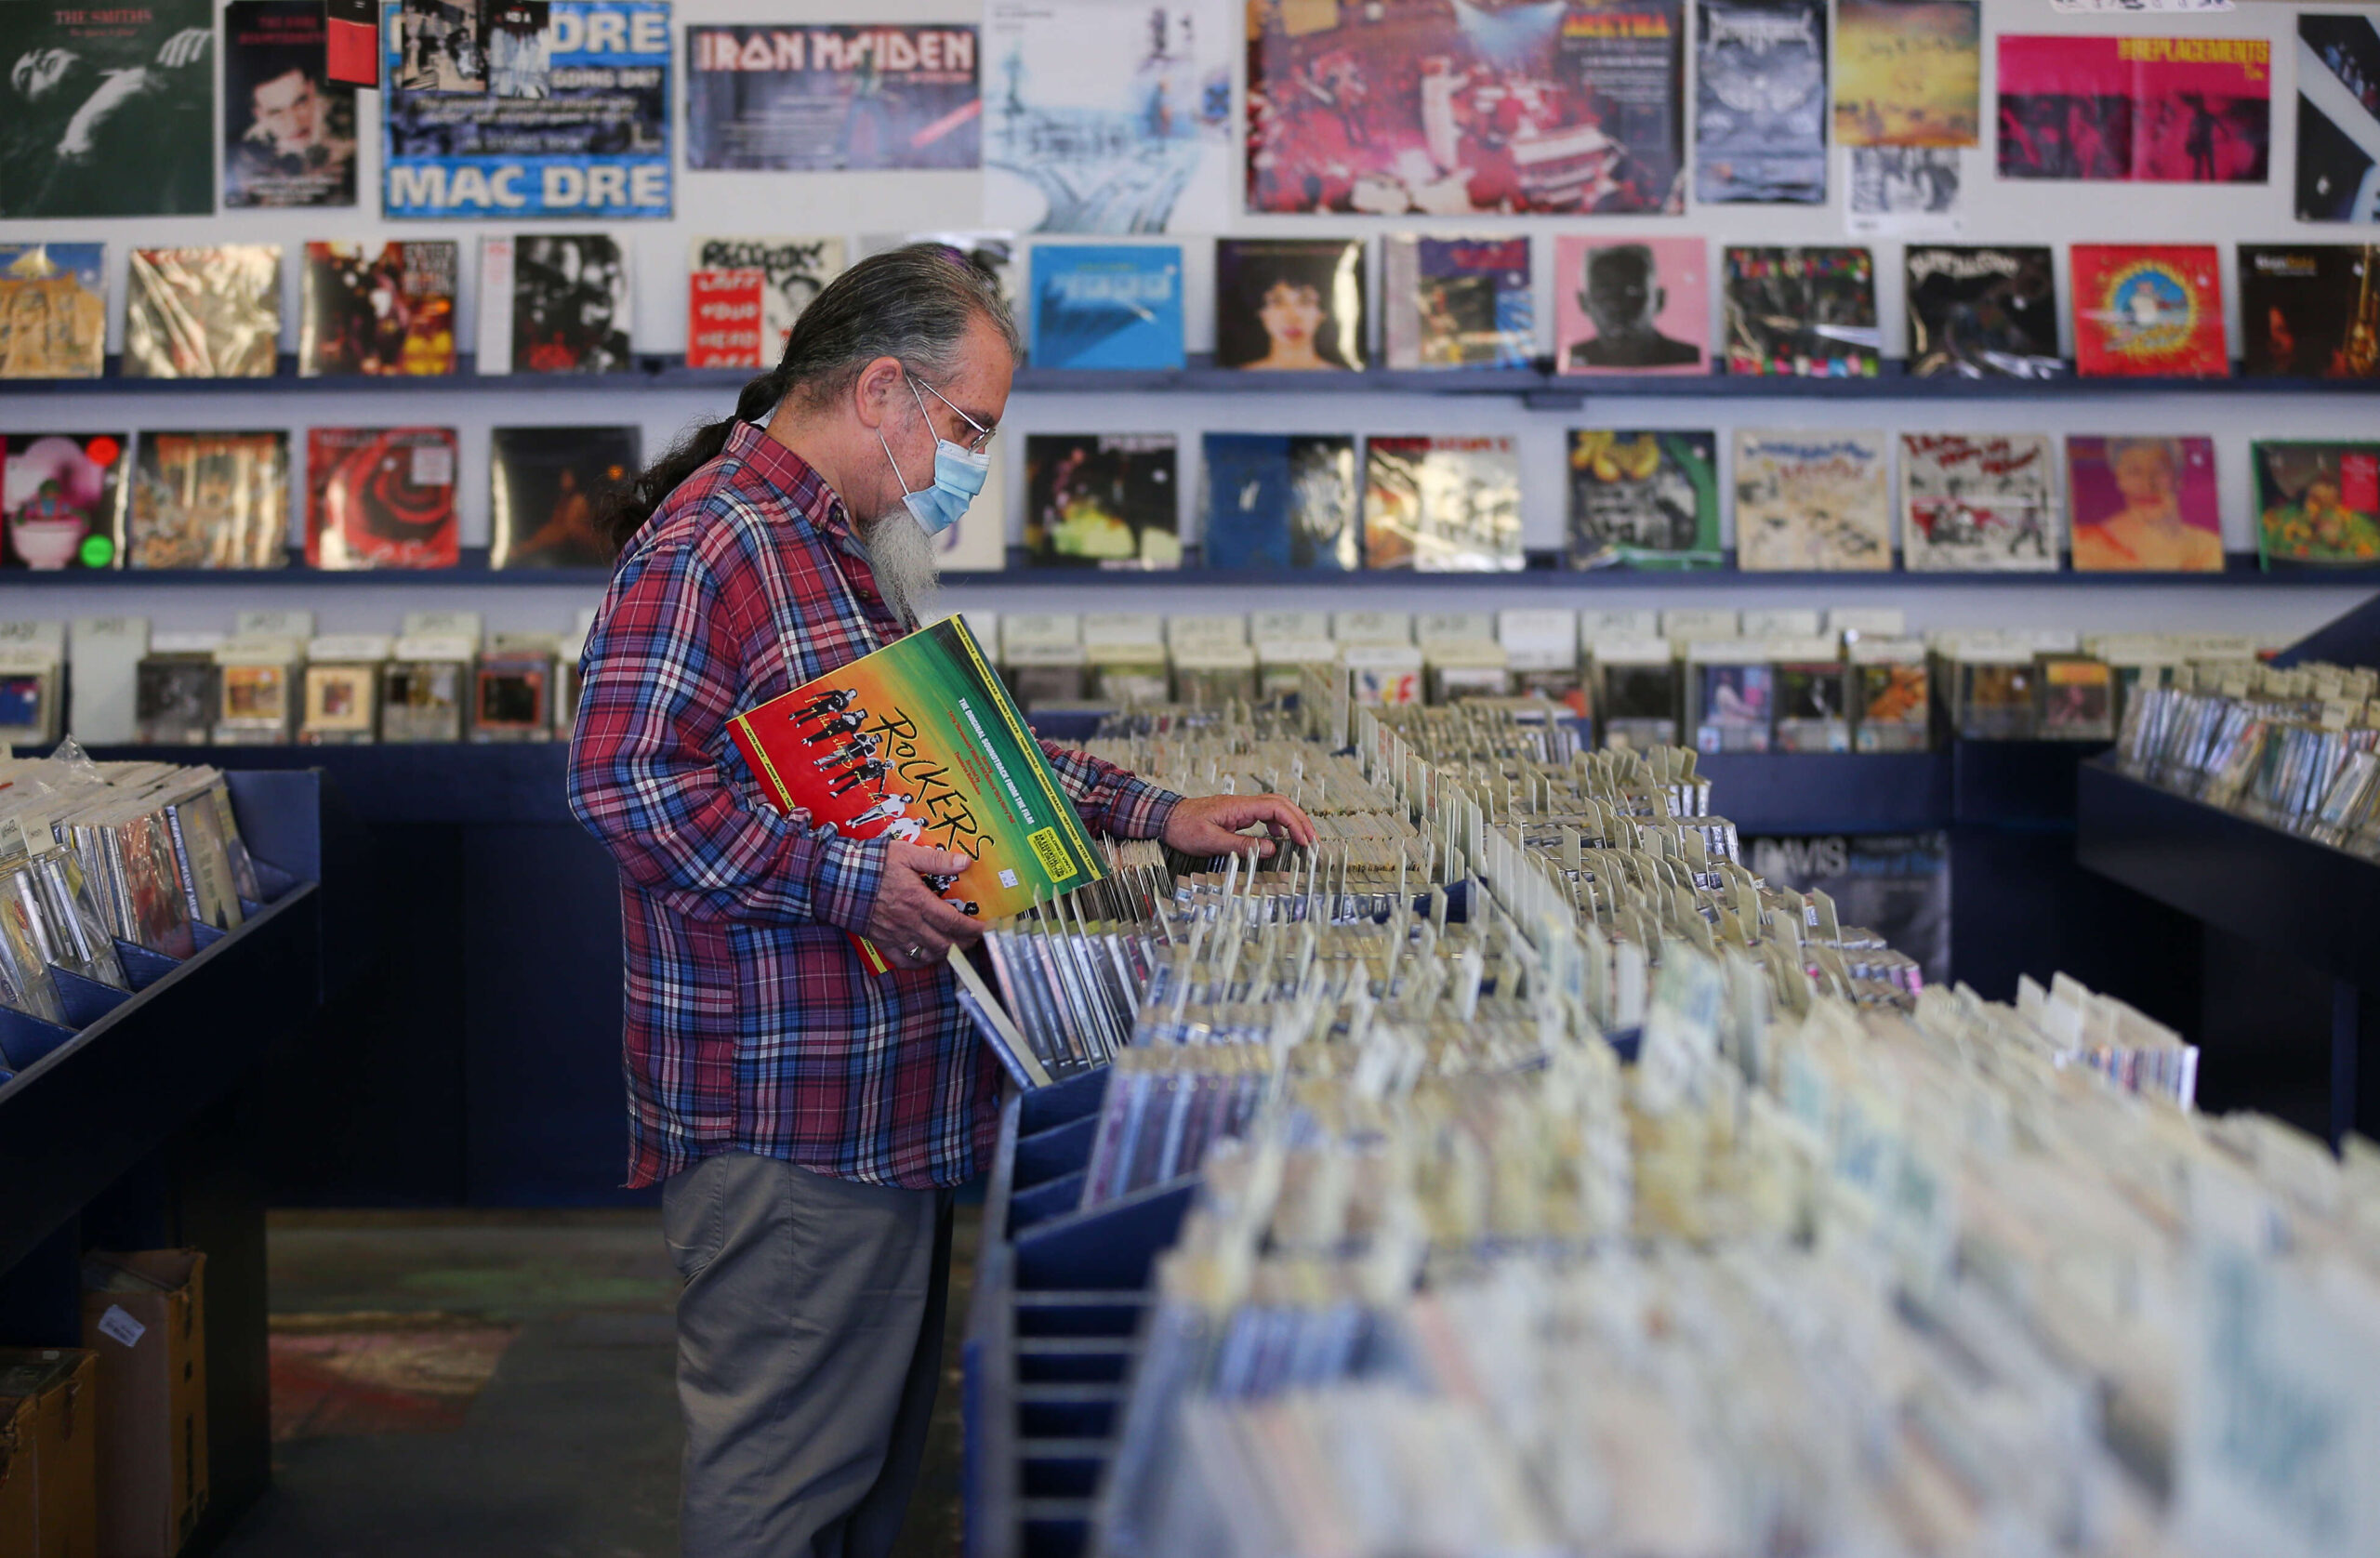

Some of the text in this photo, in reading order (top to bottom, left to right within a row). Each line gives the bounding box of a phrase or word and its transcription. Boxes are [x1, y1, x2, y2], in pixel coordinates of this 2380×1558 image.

[54, 7, 152, 24] THE SMITHS
[550, 11, 668, 53] DRE
[699, 31, 975, 71] IRON MAIDEN
[390, 165, 668, 208] MAC DRE
[963, 638, 975, 654] CIRCLE
[974, 657, 998, 695] BURNING SPEAR
[997, 698, 1009, 715] BUNNY
[745, 727, 764, 758] JUSTIN HINES
[1018, 736, 1038, 769] THIRD WORLD
[765, 762, 785, 794] JUNIOR BYLES
[958, 697, 1035, 825] THE ORIGINAL SOUNDTRACK FROM THE FILM
[866, 705, 996, 863] ROCKERS
[1038, 772, 1063, 812] GREGORY ISAACS
[1062, 815, 1078, 840] HEPTONES
[1034, 835, 1046, 852] REGGAE
[1043, 852, 1061, 878] COLLECTION
[1042, 840, 1058, 865] ESSENTIAL
[1046, 828, 1064, 856] COLORED
[1061, 855, 1073, 872] VINYL
[1078, 843, 1095, 871] PETER TOSH
